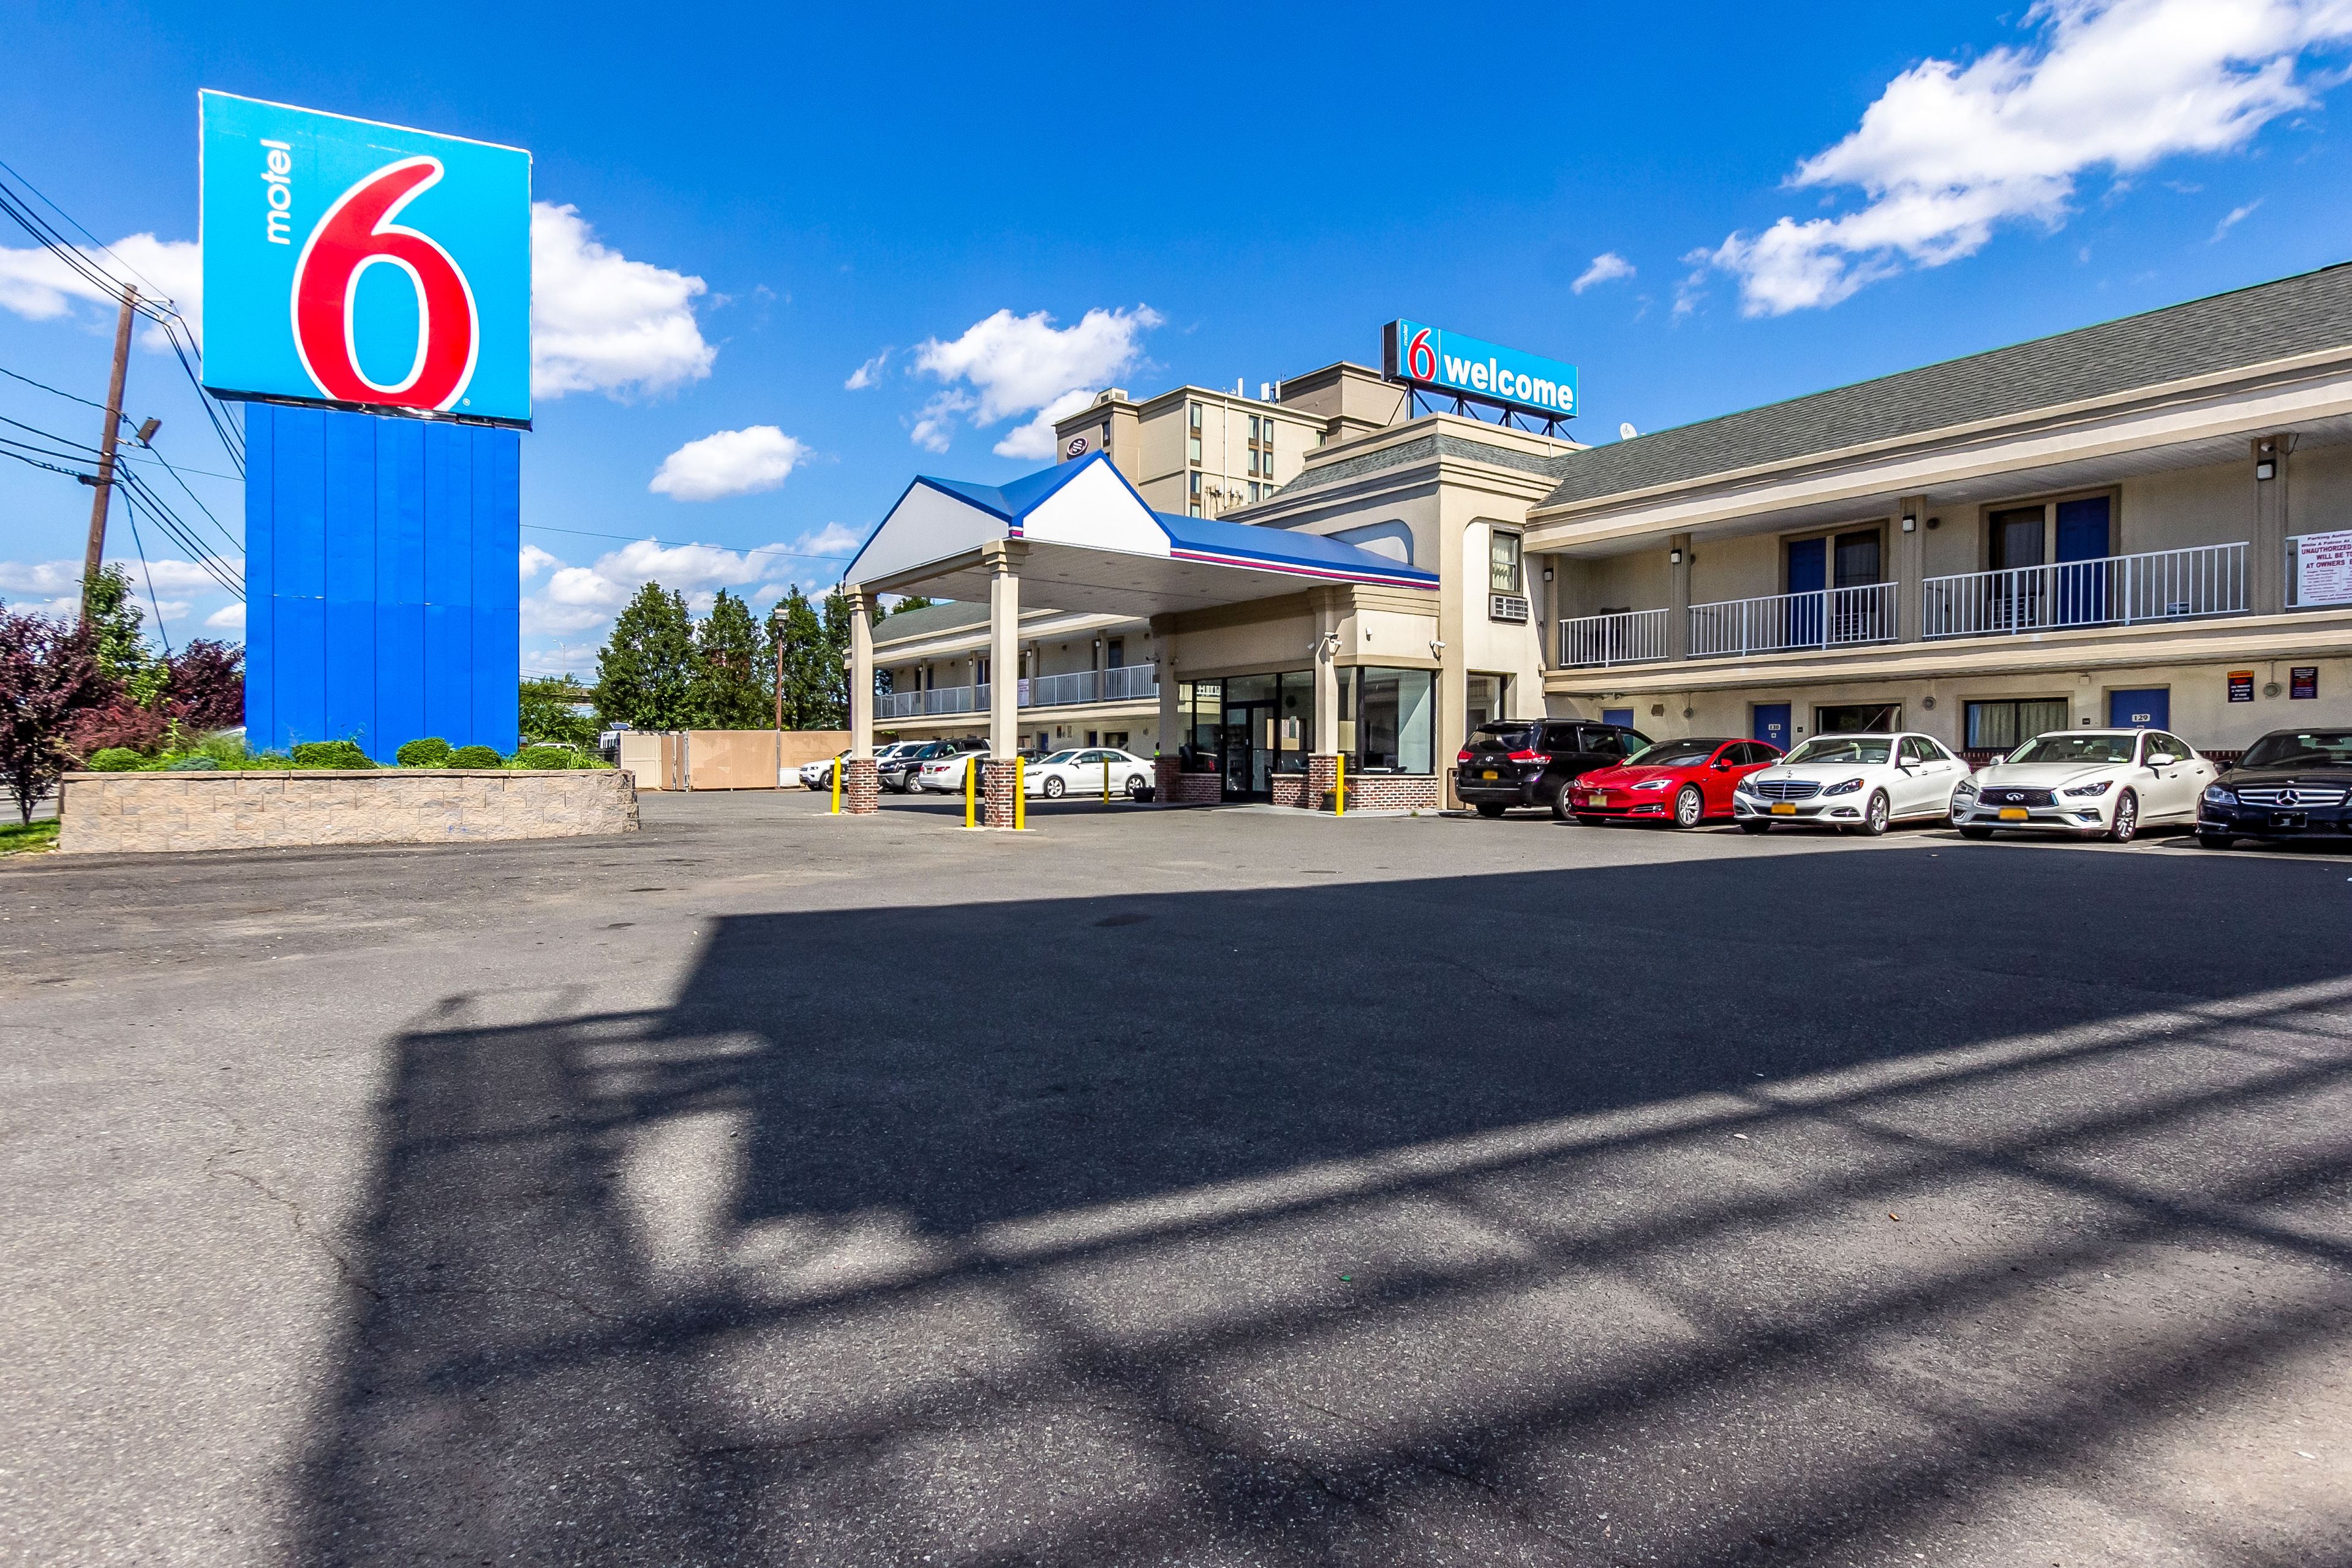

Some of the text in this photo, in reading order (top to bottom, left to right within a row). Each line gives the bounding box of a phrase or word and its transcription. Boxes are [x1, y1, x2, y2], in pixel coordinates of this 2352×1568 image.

[260, 139, 292, 245] motel
[290, 156, 480, 411] 6
[1408, 328, 1437, 382] 6
[1444, 354, 1574, 410] welcome
[2301, 544, 2351, 555] UNAUTHORIZED
[2316, 559, 2345, 568] OWNERS
